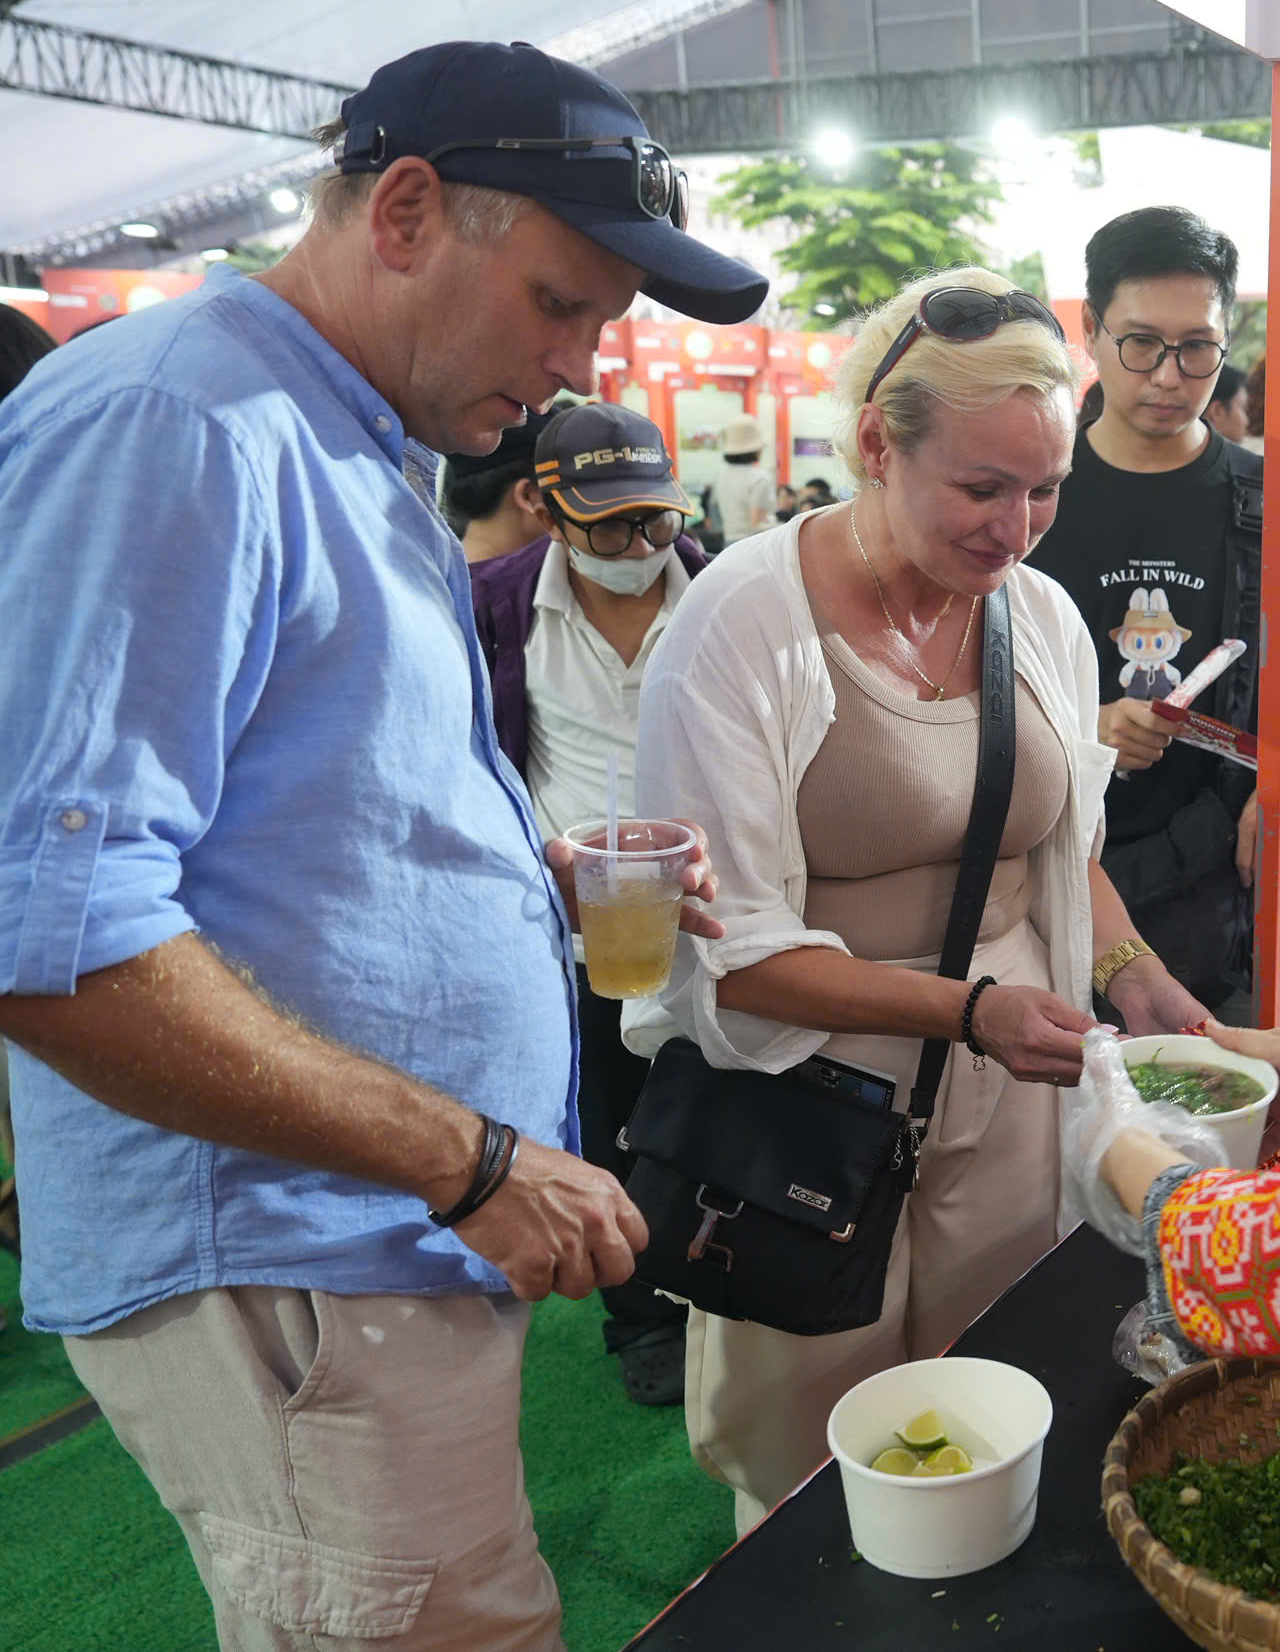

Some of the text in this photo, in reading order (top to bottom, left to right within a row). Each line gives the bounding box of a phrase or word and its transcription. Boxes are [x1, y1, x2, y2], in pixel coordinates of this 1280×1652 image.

[574, 446, 632, 470] PG-1
[1128, 559, 1141, 567] THE
[1100, 568, 1205, 590] FALL IN WILD
[790, 1186, 829, 1208] Kazar
